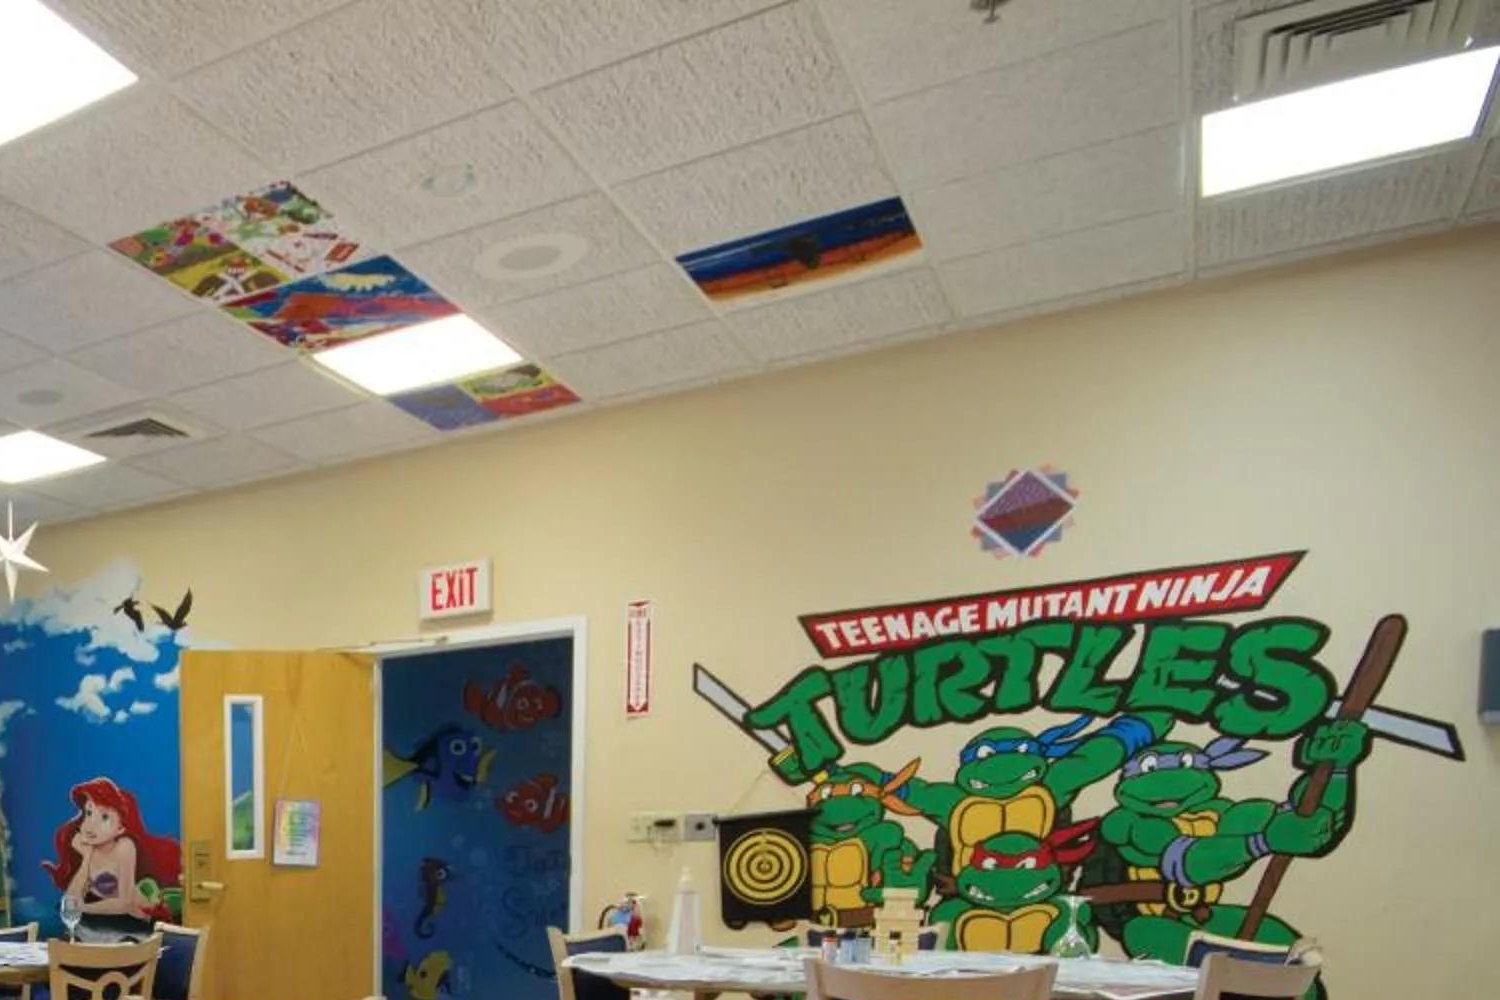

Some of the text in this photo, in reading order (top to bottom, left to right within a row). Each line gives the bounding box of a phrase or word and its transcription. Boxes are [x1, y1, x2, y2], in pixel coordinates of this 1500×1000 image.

[431, 567, 478, 610] EXIT
[815, 565, 1272, 649] TEENAGE MUTANT NINJA
[743, 617, 1339, 771] TURTLES
